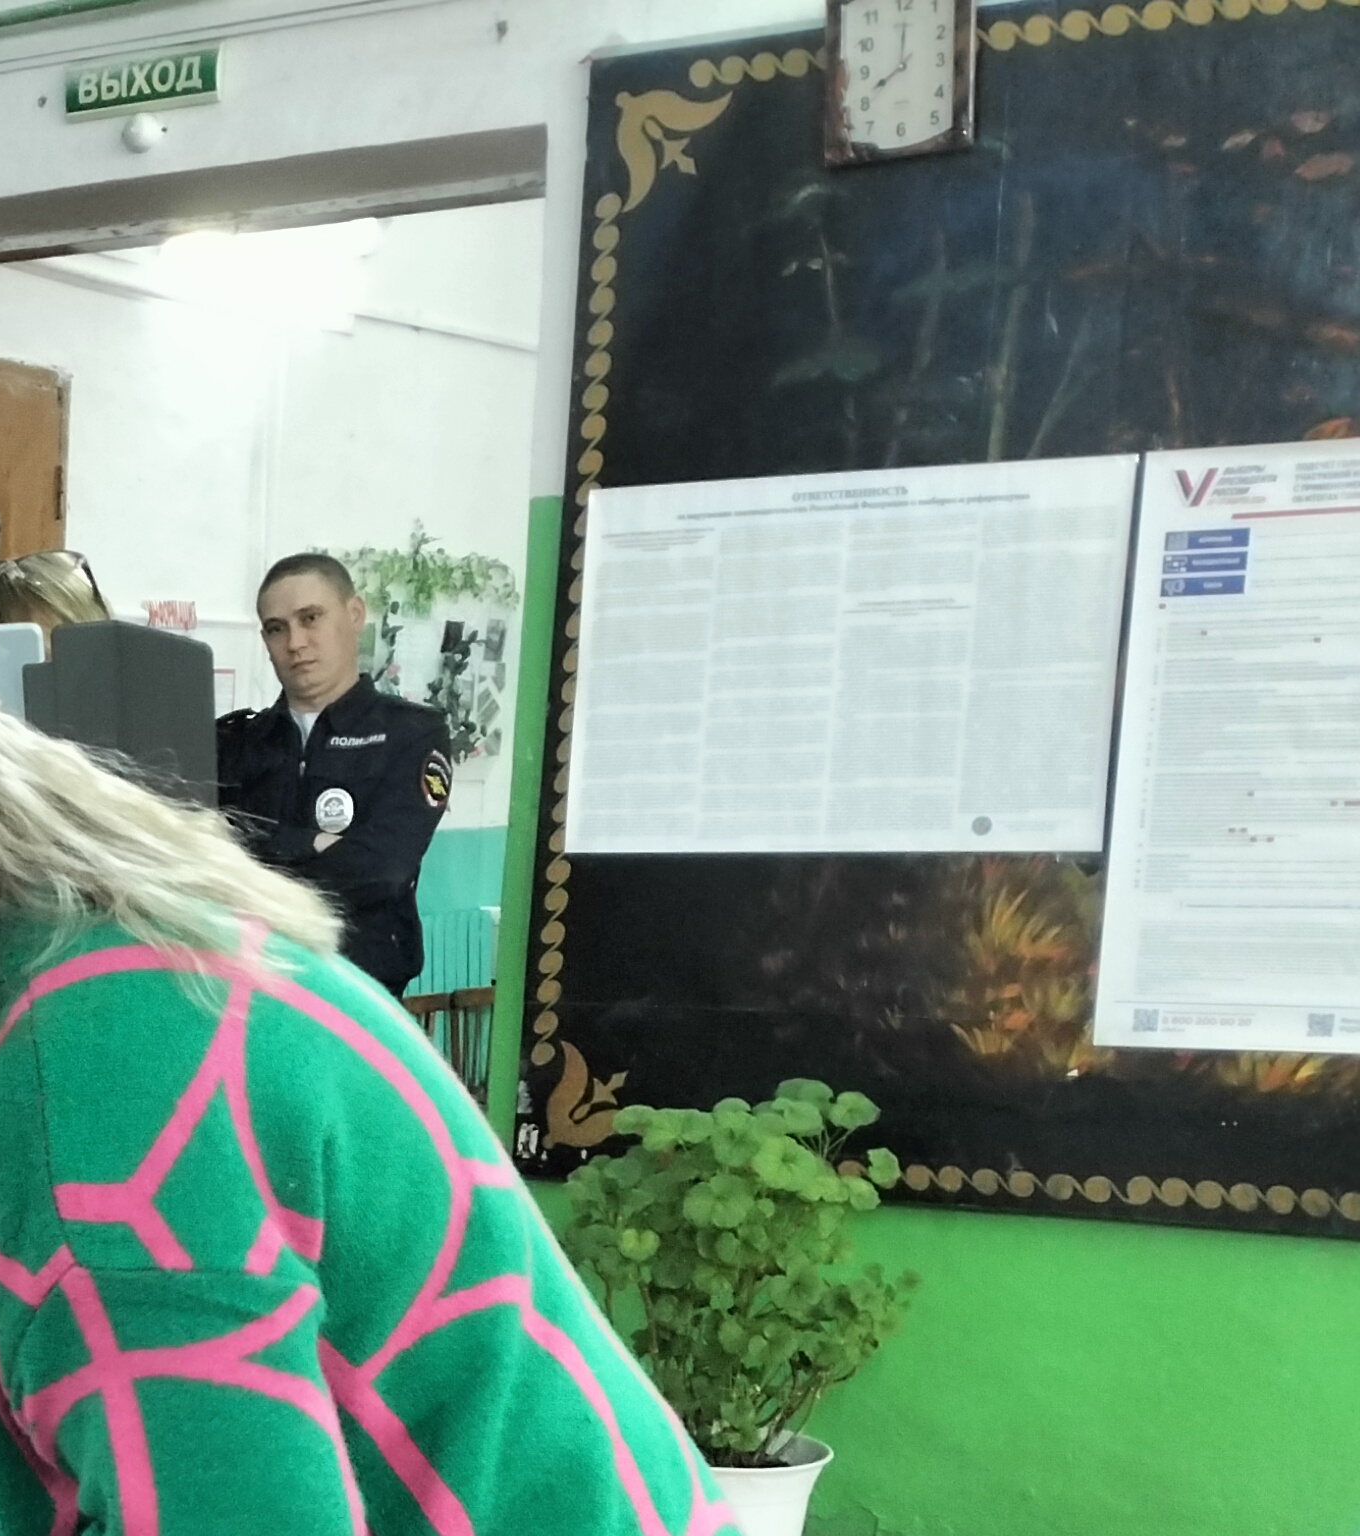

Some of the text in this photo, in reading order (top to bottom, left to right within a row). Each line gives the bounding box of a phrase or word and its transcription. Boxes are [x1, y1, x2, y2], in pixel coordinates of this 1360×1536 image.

[895, 0, 913, 12] 12
[863, 9, 878, 25] 11
[936, 24, 946, 40] 2
[858, 37, 874, 53] 10
[936, 52, 945, 67] 3
[78, 55, 203, 105] ВЫХОД
[860, 65, 870, 80] 9
[934, 84, 944, 99] 4
[860, 96, 870, 111] 8
[930, 110, 939, 125] 5
[865, 120, 875, 135] 7
[896, 122, 906, 137] 6
